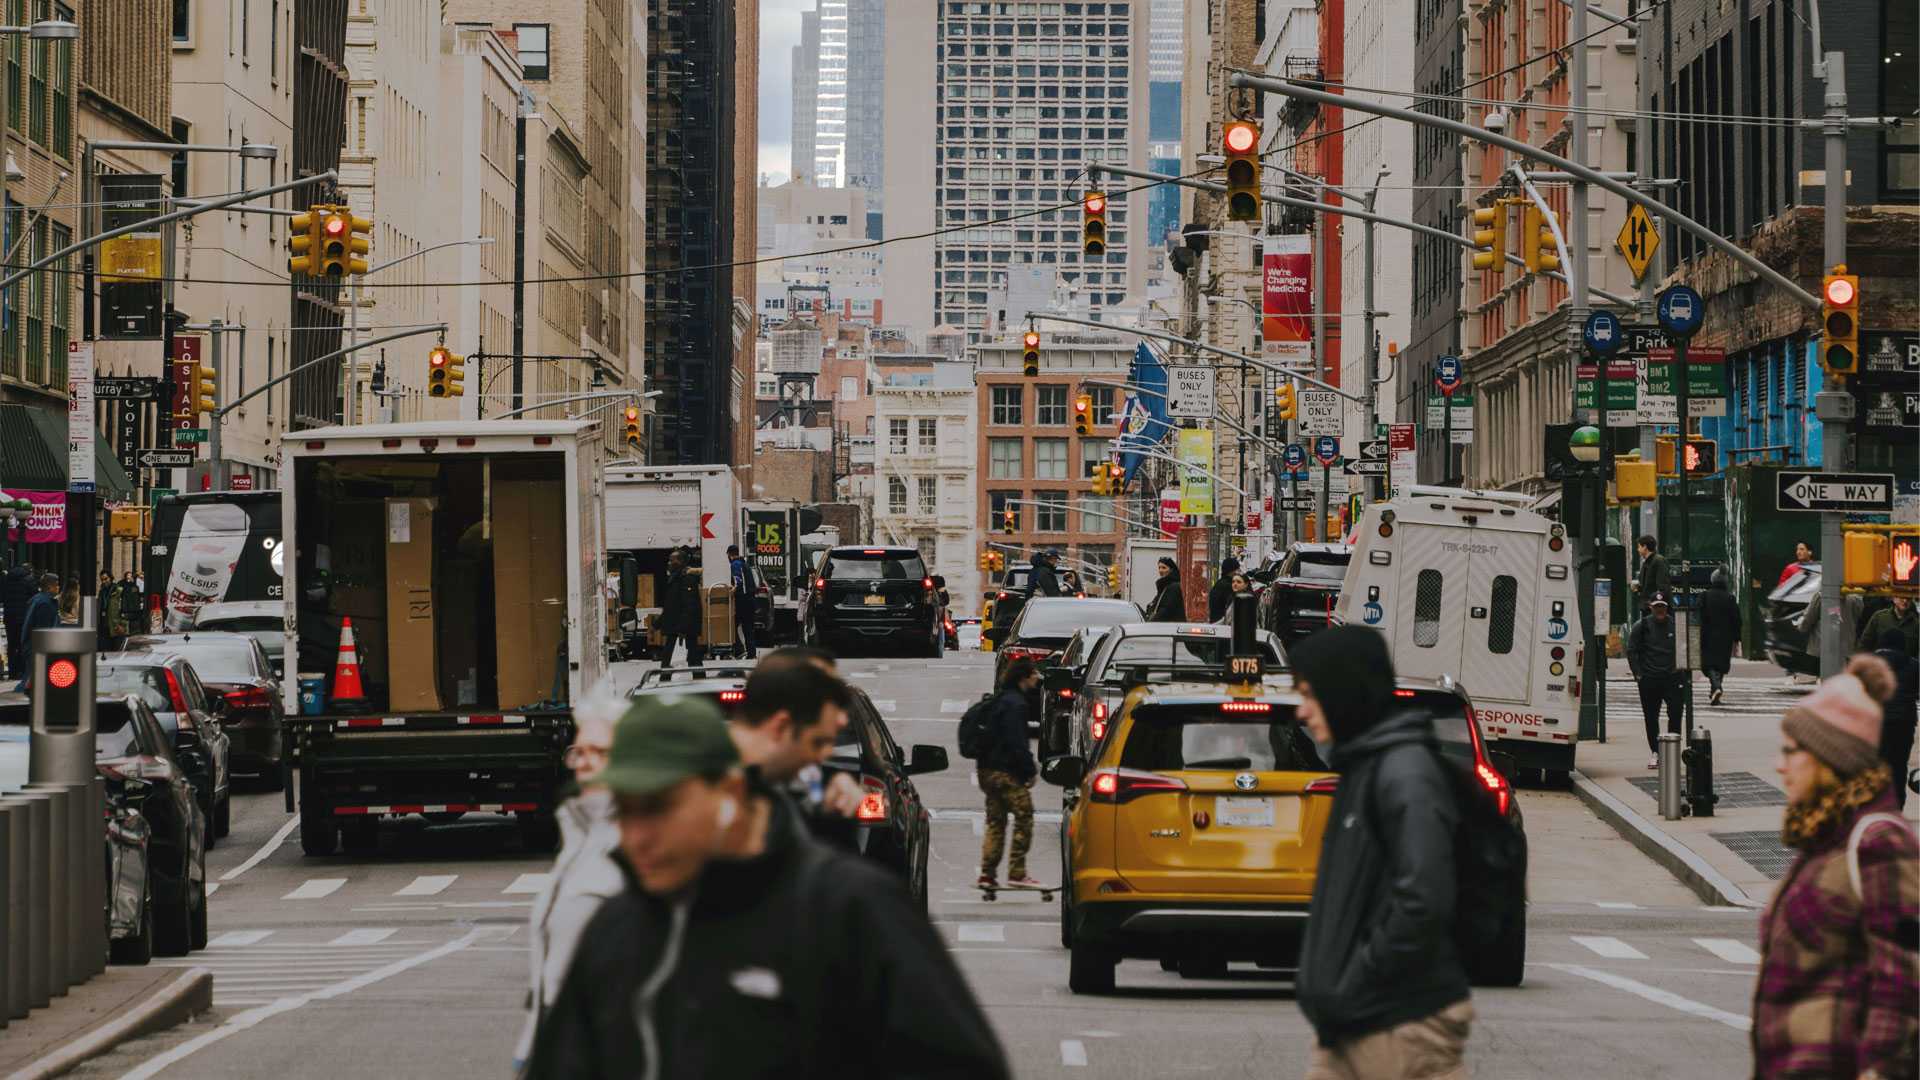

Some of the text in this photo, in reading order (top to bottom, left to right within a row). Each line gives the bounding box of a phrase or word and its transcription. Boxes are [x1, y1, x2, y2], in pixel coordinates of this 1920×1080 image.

[1267, 277, 1307, 287] Changing
[1267, 285, 1306, 293] Medicine.
[1636, 336, 1668, 350] Park
[1177, 371, 1206, 380] BUSES
[1650, 366, 1668, 377] BM1
[94, 384, 122, 397] urray
[1180, 382, 1202, 391] ONLY
[1650, 382, 1670, 393] BM2
[1305, 394, 1336, 402] BUSES
[1308, 407, 1332, 416] ONLY
[125, 399, 135, 480] COFFEE
[176, 431, 195, 442] urray
[1370, 446, 1385, 454] ONE
[146, 455, 161, 463] ONE
[1353, 463, 1367, 471] ONE
[1796, 485, 1879, 500] ONE WAY
[27, 517, 63, 527] ONUTS
[757, 544, 781, 554] FOODS
[758, 556, 784, 567] RONTO
[180, 571, 219, 589] CELSIUS
[1363, 606, 1381, 619] MTA
[1548, 622, 1567, 635] MTA
[1232, 658, 1258, 674] 9T75
[1475, 709, 1544, 727] ESPONSE
